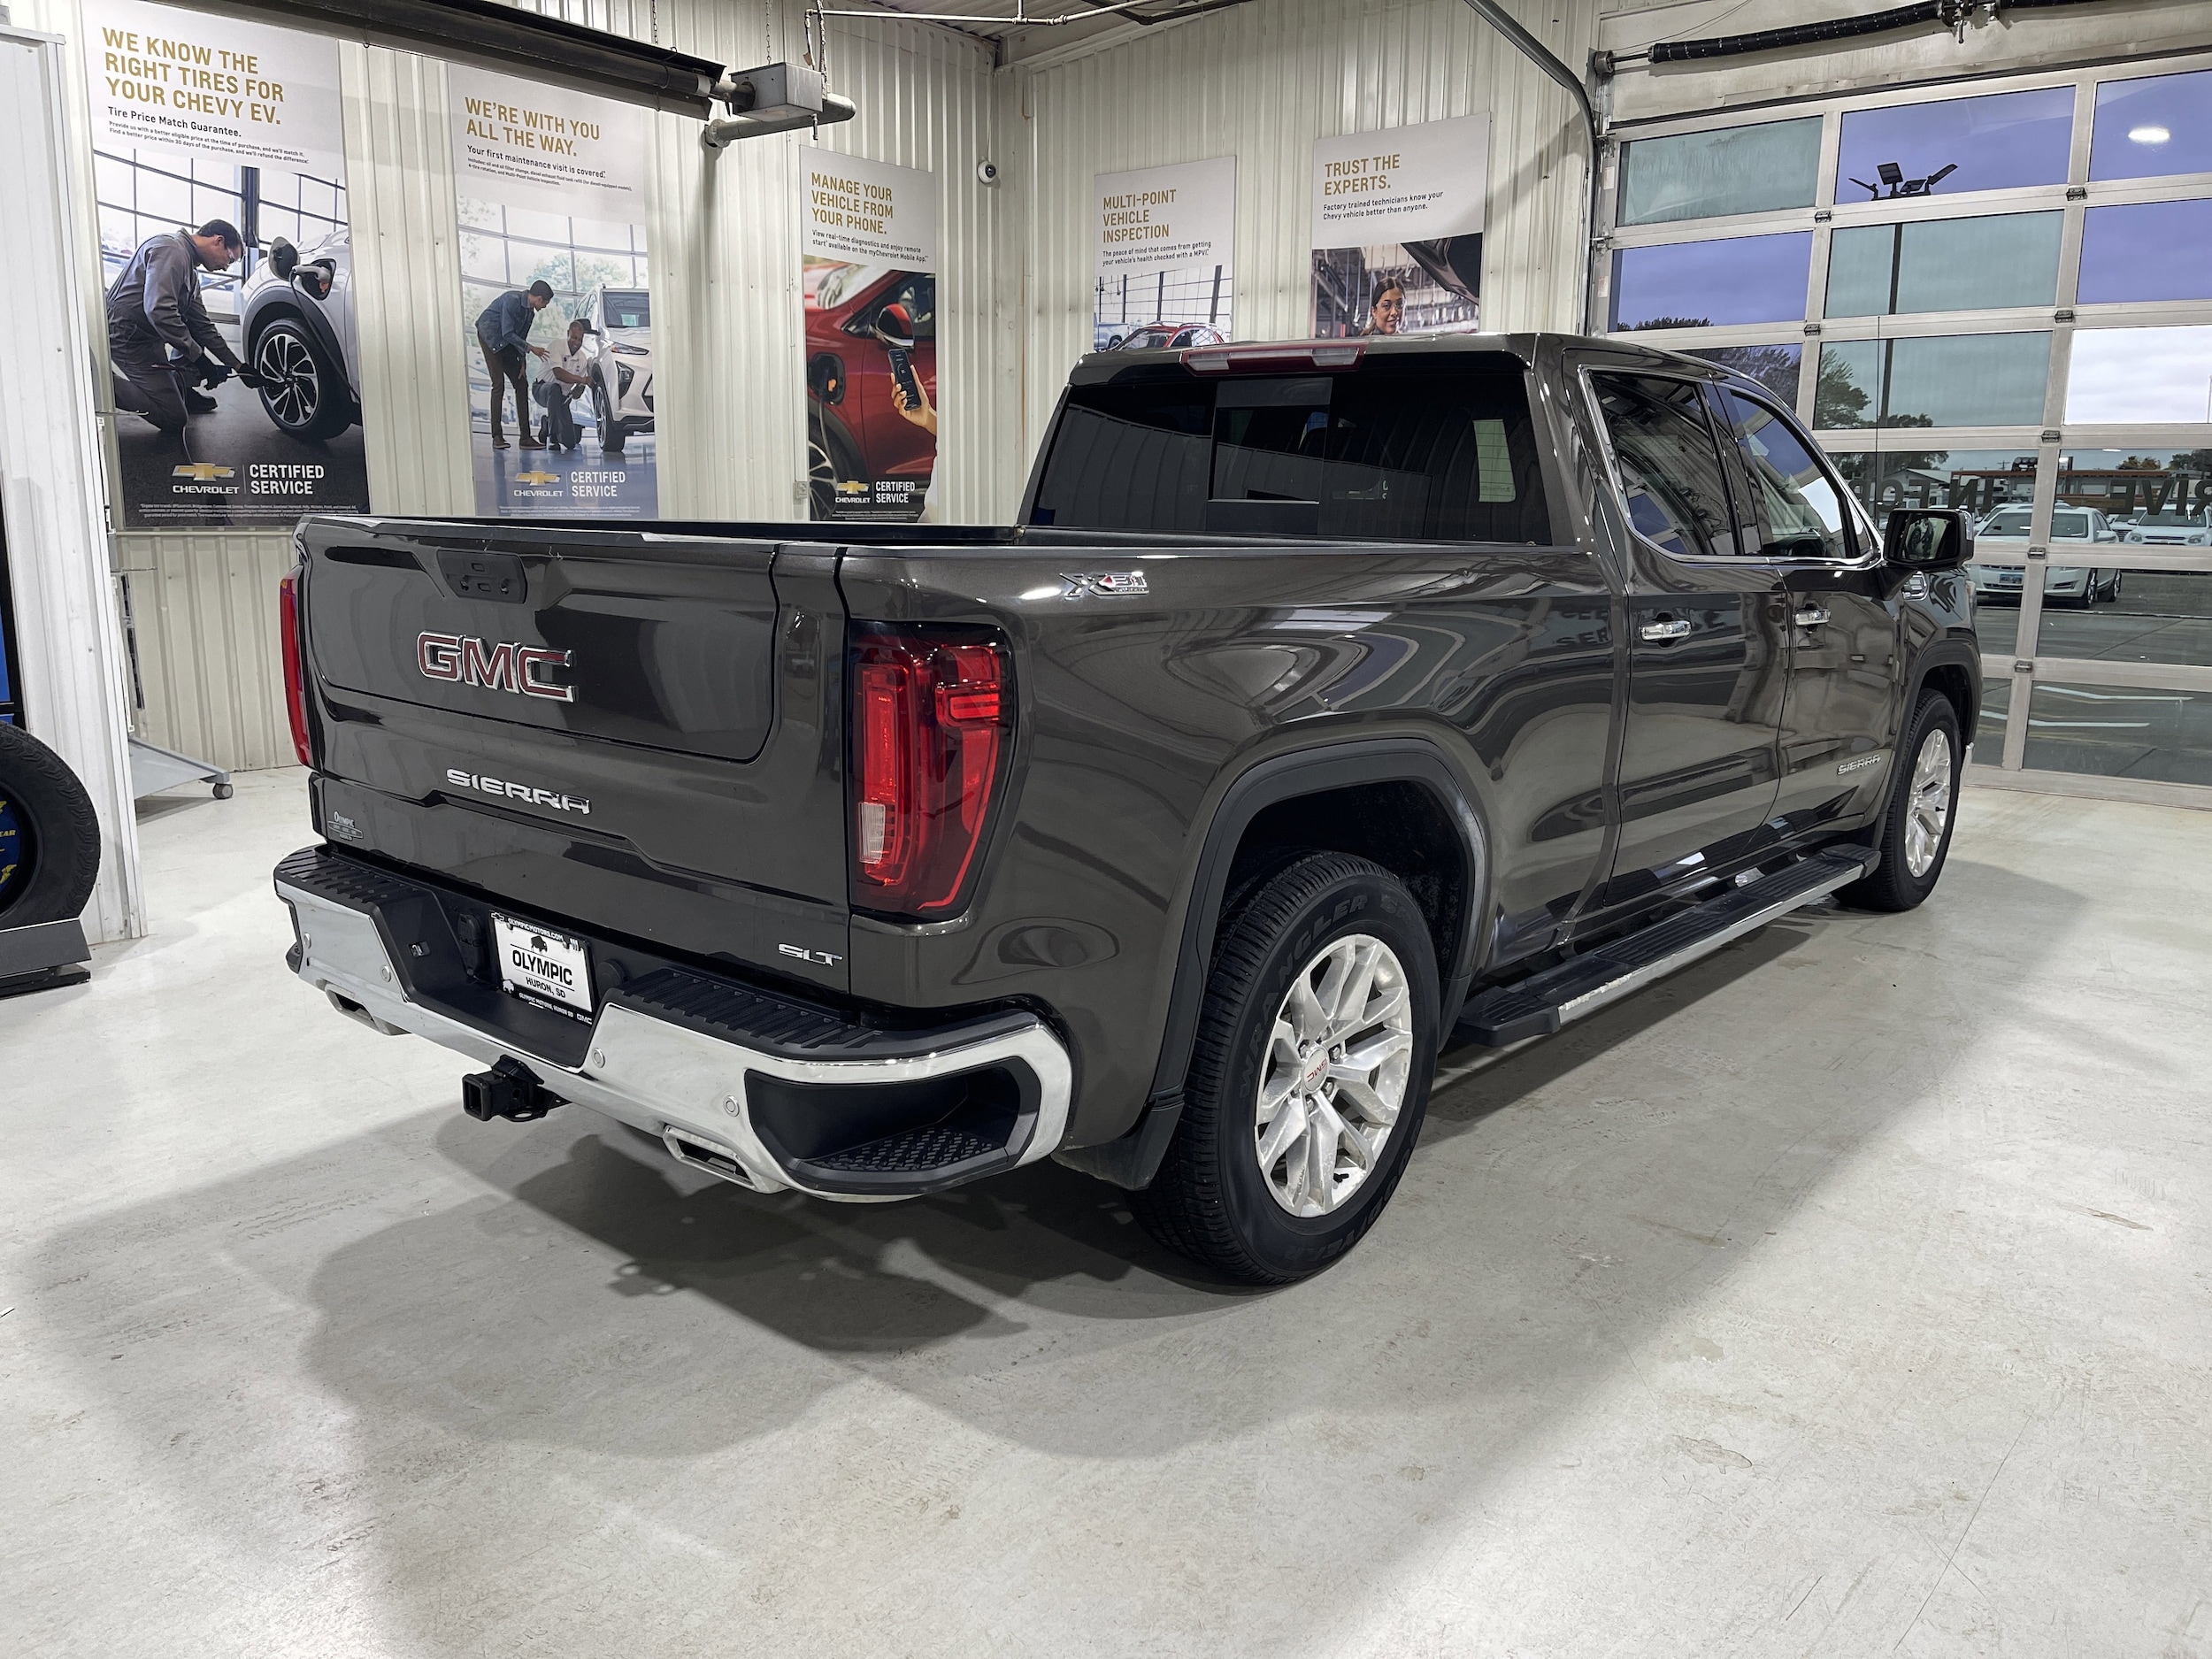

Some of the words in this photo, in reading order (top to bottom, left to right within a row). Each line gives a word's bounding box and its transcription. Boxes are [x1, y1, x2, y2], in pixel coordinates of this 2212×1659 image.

[103, 27, 139, 52] WE
[147, 36, 211, 65] KNOW
[219, 50, 257, 74] THE
[104, 53, 172, 82] RIGHT
[178, 66, 239, 94] TIRES
[246, 79, 284, 102] FOR
[105, 77, 166, 105] YOUR
[173, 90, 243, 119] CHEVY
[251, 104, 280, 125] EV.
[108, 106, 127, 118] Tire
[131, 111, 156, 123] Price
[159, 116, 188, 128] Match
[190, 122, 242, 137] Guarantee.
[465, 96, 518, 124] WE'RE
[524, 110, 565, 134] WITH
[569, 119, 600, 141] YOU
[466, 119, 499, 141] ALL
[503, 127, 534, 149] THE
[540, 134, 578, 157] WAY.
[467, 145, 485, 156] Your
[487, 149, 503, 160] first
[505, 155, 550, 169] maintenance
[552, 163, 567, 173] visit
[1325, 157, 1369, 178] TRUST
[1373, 154, 1401, 172] THE
[811, 172, 860, 196] MANAGE
[864, 183, 892, 202] YOUR
[1325, 175, 1391, 196] EXPERTS.
[811, 190, 860, 212] VEHICLE
[864, 201, 893, 219] FROM
[1103, 189, 1177, 211] MULTI-POINT
[1348, 200, 1371, 209] trained
[1372, 196, 1408, 206] technicians
[1409, 193, 1427, 202] know
[1428, 191, 1443, 201] your
[811, 207, 842, 227] YOUR
[847, 215, 887, 234] PHONE.
[1102, 209, 1149, 227] VEHICLE
[1343, 210, 1364, 219] vehicle
[1403, 204, 1428, 212] anyone.
[826, 234, 850, 242] real-time
[851, 237, 879, 248] diagnostics
[1103, 224, 1170, 243] INSPECTION
[829, 242, 850, 251] available
[869, 250, 899, 259] myChevrolet
[1192, 241, 1211, 250] getting
[1115, 256, 1136, 265] vehicle's
[250, 464, 325, 479] CERTIFIED
[570, 472, 626, 483] CERTIFIED
[173, 485, 239, 495] CHEVROLET
[250, 480, 313, 495] SERVICE
[572, 486, 618, 497] SERVICE
[876, 481, 915, 492] CERTIFIED
[876, 493, 909, 503] SERVICE
[417, 630, 579, 703] GMC
[1837, 754, 1881, 775] SIERRA
[446, 768, 592, 815] SIERRA
[779, 943, 843, 966] SLT
[512, 950, 572, 986] OLYMPIC
[526, 977, 555, 995] HURON,
[557, 987, 566, 998] SD
[1240, 895, 1367, 1099] WRANGLER
[577, 1013, 592, 1025] GMC
[1307, 1057, 1327, 1082] GMC
